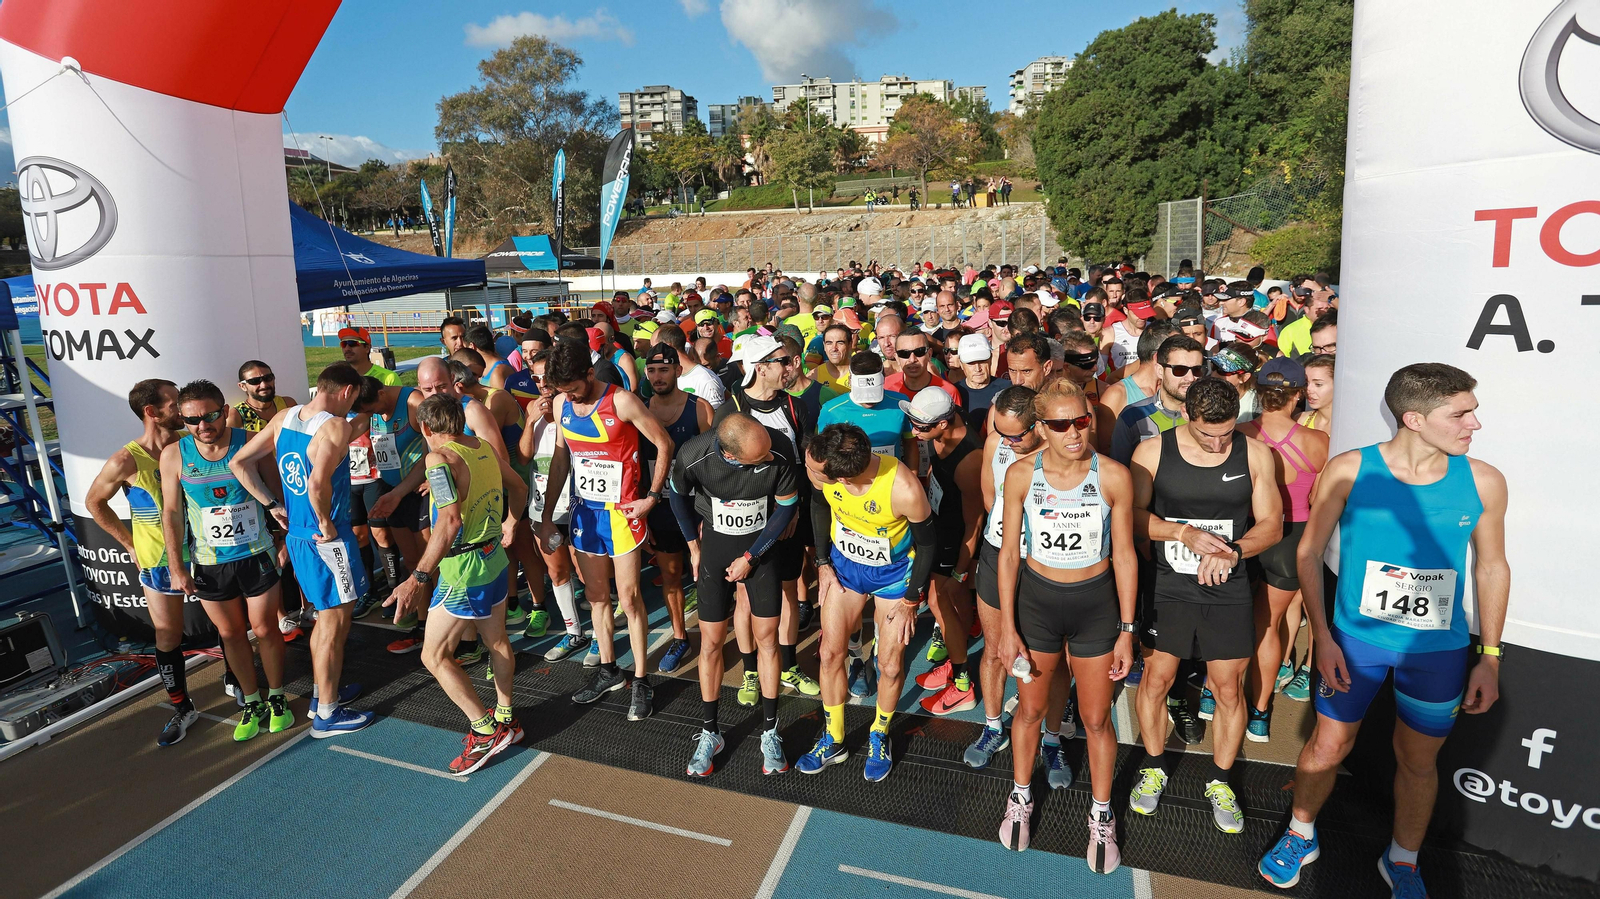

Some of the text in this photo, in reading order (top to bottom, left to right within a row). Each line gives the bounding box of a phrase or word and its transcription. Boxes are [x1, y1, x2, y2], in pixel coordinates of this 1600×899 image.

[333, 276, 381, 289] Ayuntamiento
[391, 273, 419, 284] Algeciras
[594, 462, 615, 470] Vopak
[579, 475, 607, 493] 213
[227, 504, 250, 513] Vopak
[736, 500, 760, 508] Vopak
[221, 513, 243, 522] MARIO
[717, 511, 764, 528] 1005A
[1061, 510, 1091, 520] Vopak
[211, 521, 246, 539] 324
[1195, 523, 1224, 531] Vopak
[1040, 531, 1082, 551] 342
[839, 540, 888, 562] 1002A
[82, 563, 130, 586] TOYOTA
[1410, 572, 1444, 583] Vopak
[1395, 581, 1433, 592] SERGIO
[1376, 589, 1429, 617] 148
[1453, 767, 1600, 831] @toyo
